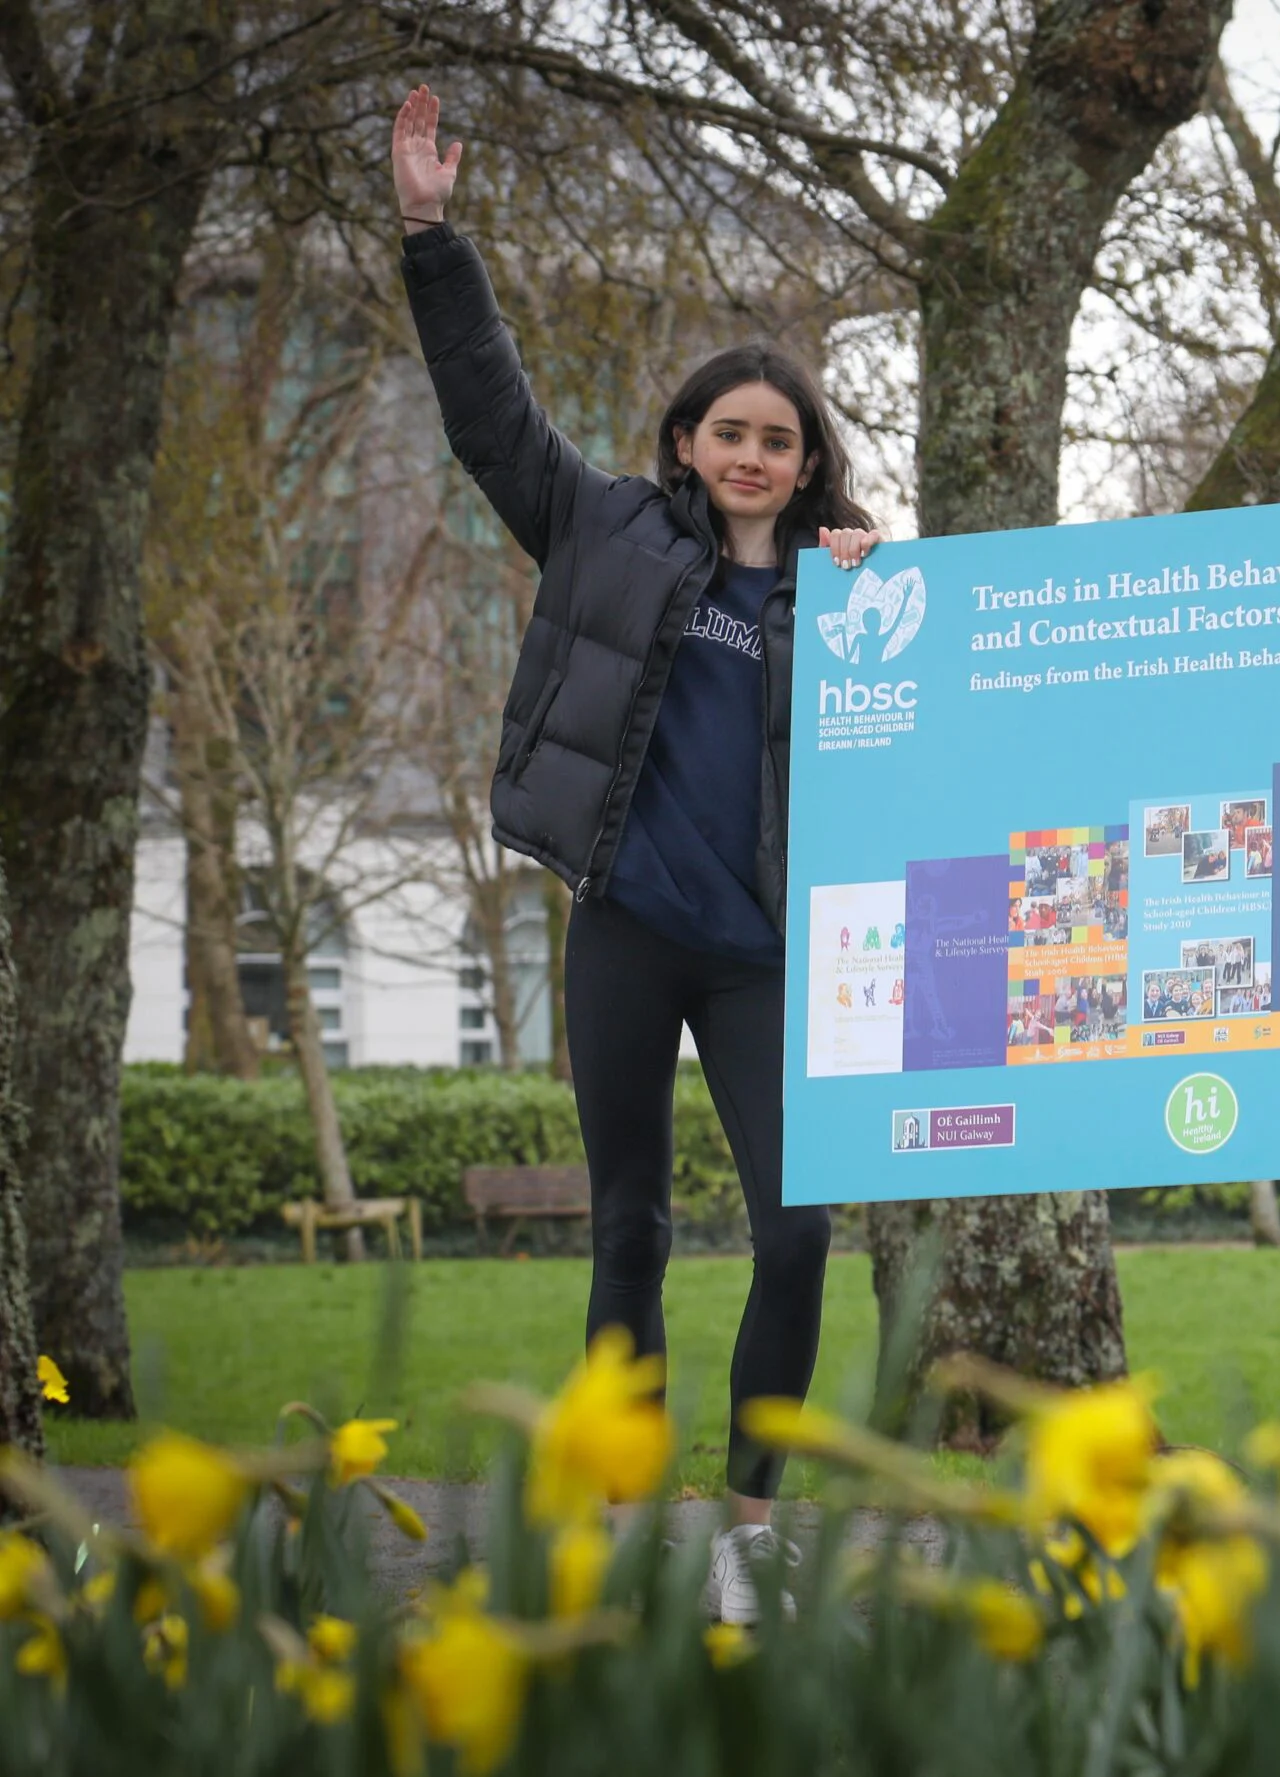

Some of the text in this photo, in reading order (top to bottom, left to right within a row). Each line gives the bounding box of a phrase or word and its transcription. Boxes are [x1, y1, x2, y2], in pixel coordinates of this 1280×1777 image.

[972, 578, 1066, 611] Trends
[1074, 578, 1101, 602] in
[1107, 565, 1200, 599] Health
[684, 607, 761, 660] LUM
[971, 622, 1021, 651] and
[1029, 606, 1180, 646] Contextual
[969, 672, 1042, 692] findings
[1046, 666, 1089, 686] from
[1094, 662, 1122, 681] the
[1127, 658, 1168, 678] Irish
[1174, 652, 1234, 674] Health
[819, 677, 918, 715] hbsc
[819, 711, 915, 727] HEALTH BEHAVIOUR IN
[875, 722, 915, 734] CHILDREN
[936, 939, 950, 948] The
[953, 936, 986, 946] National
[1184, 1086, 1220, 1124] hi
[955, 1113, 1001, 1126] Gaillimh
[1183, 1123, 1213, 1137] Healthy
[937, 1130, 994, 1142] NUI Galway
